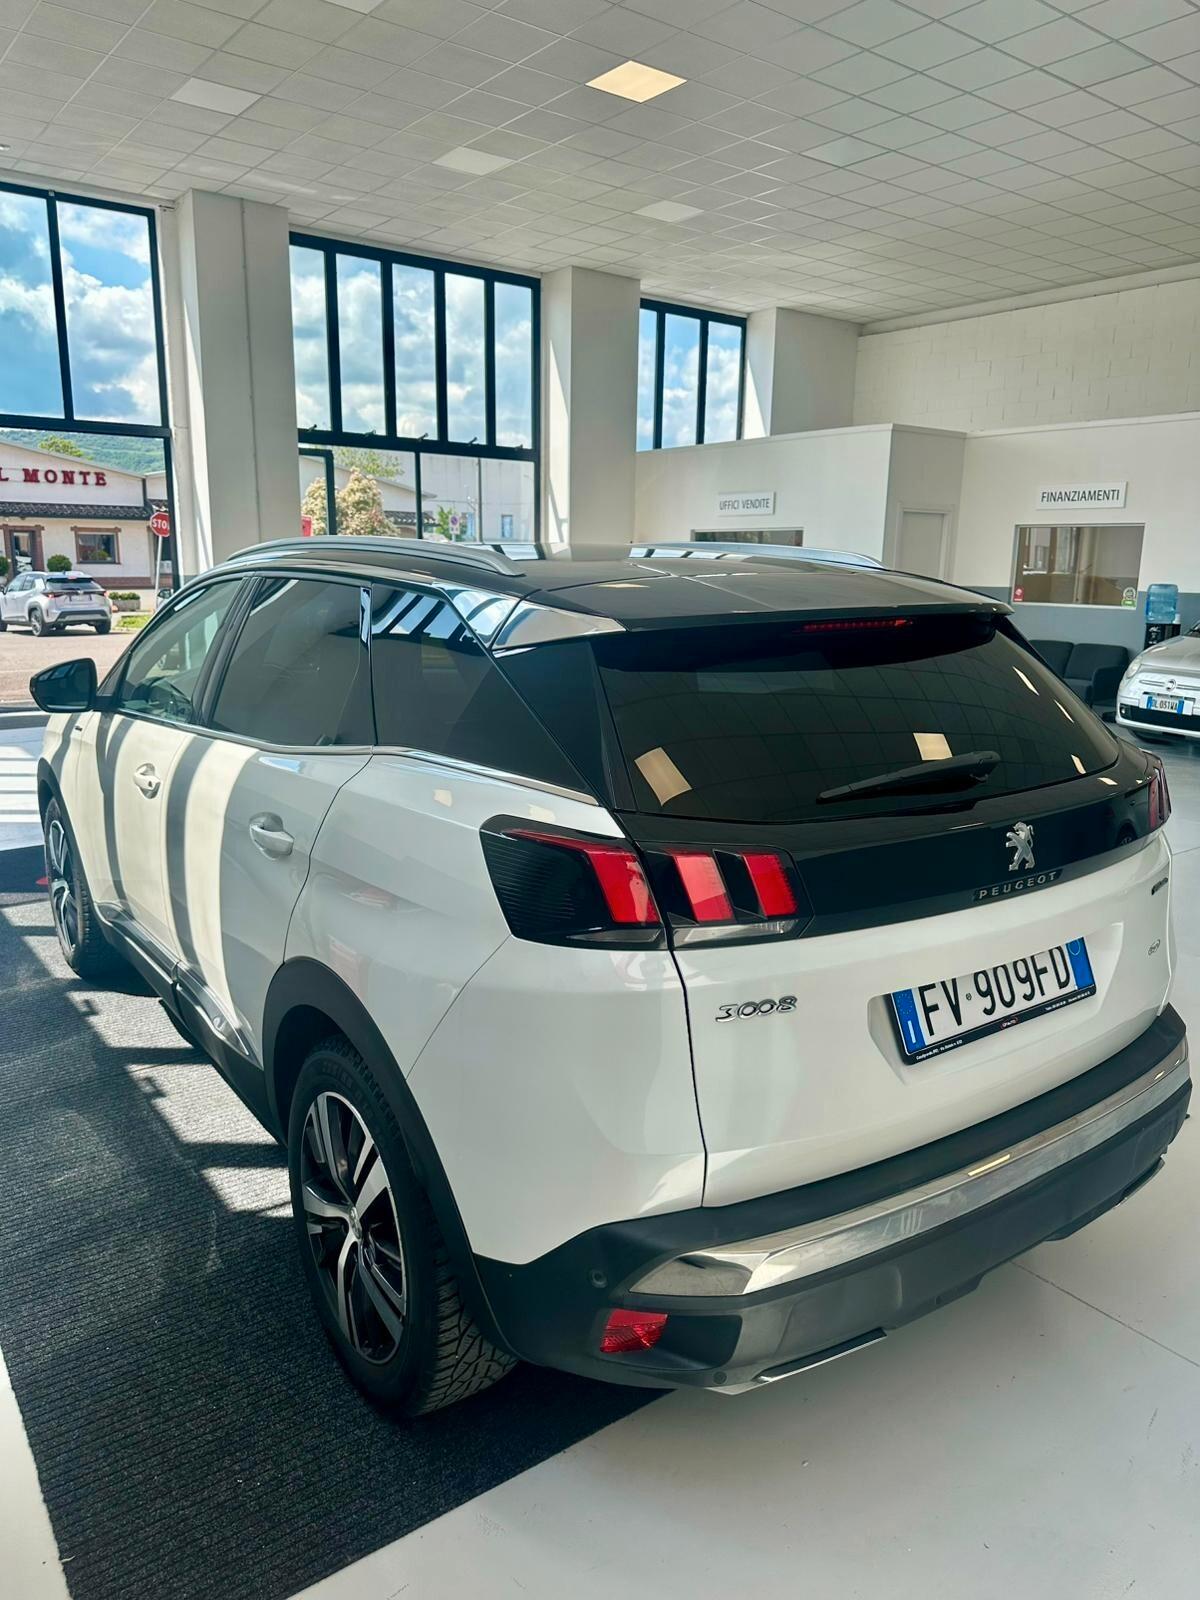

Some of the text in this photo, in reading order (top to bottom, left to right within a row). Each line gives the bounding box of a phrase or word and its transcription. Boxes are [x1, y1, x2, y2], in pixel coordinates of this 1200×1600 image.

[22, 468, 107, 486] MONTE
[719, 497, 771, 511] UFFICI VENDITE
[1041, 489, 1120, 503] FINANZIAMENTI
[979, 871, 1057, 899] PEUGEOT
[917, 945, 1071, 1036] FV 909FD
[715, 995, 798, 1023] 3008
